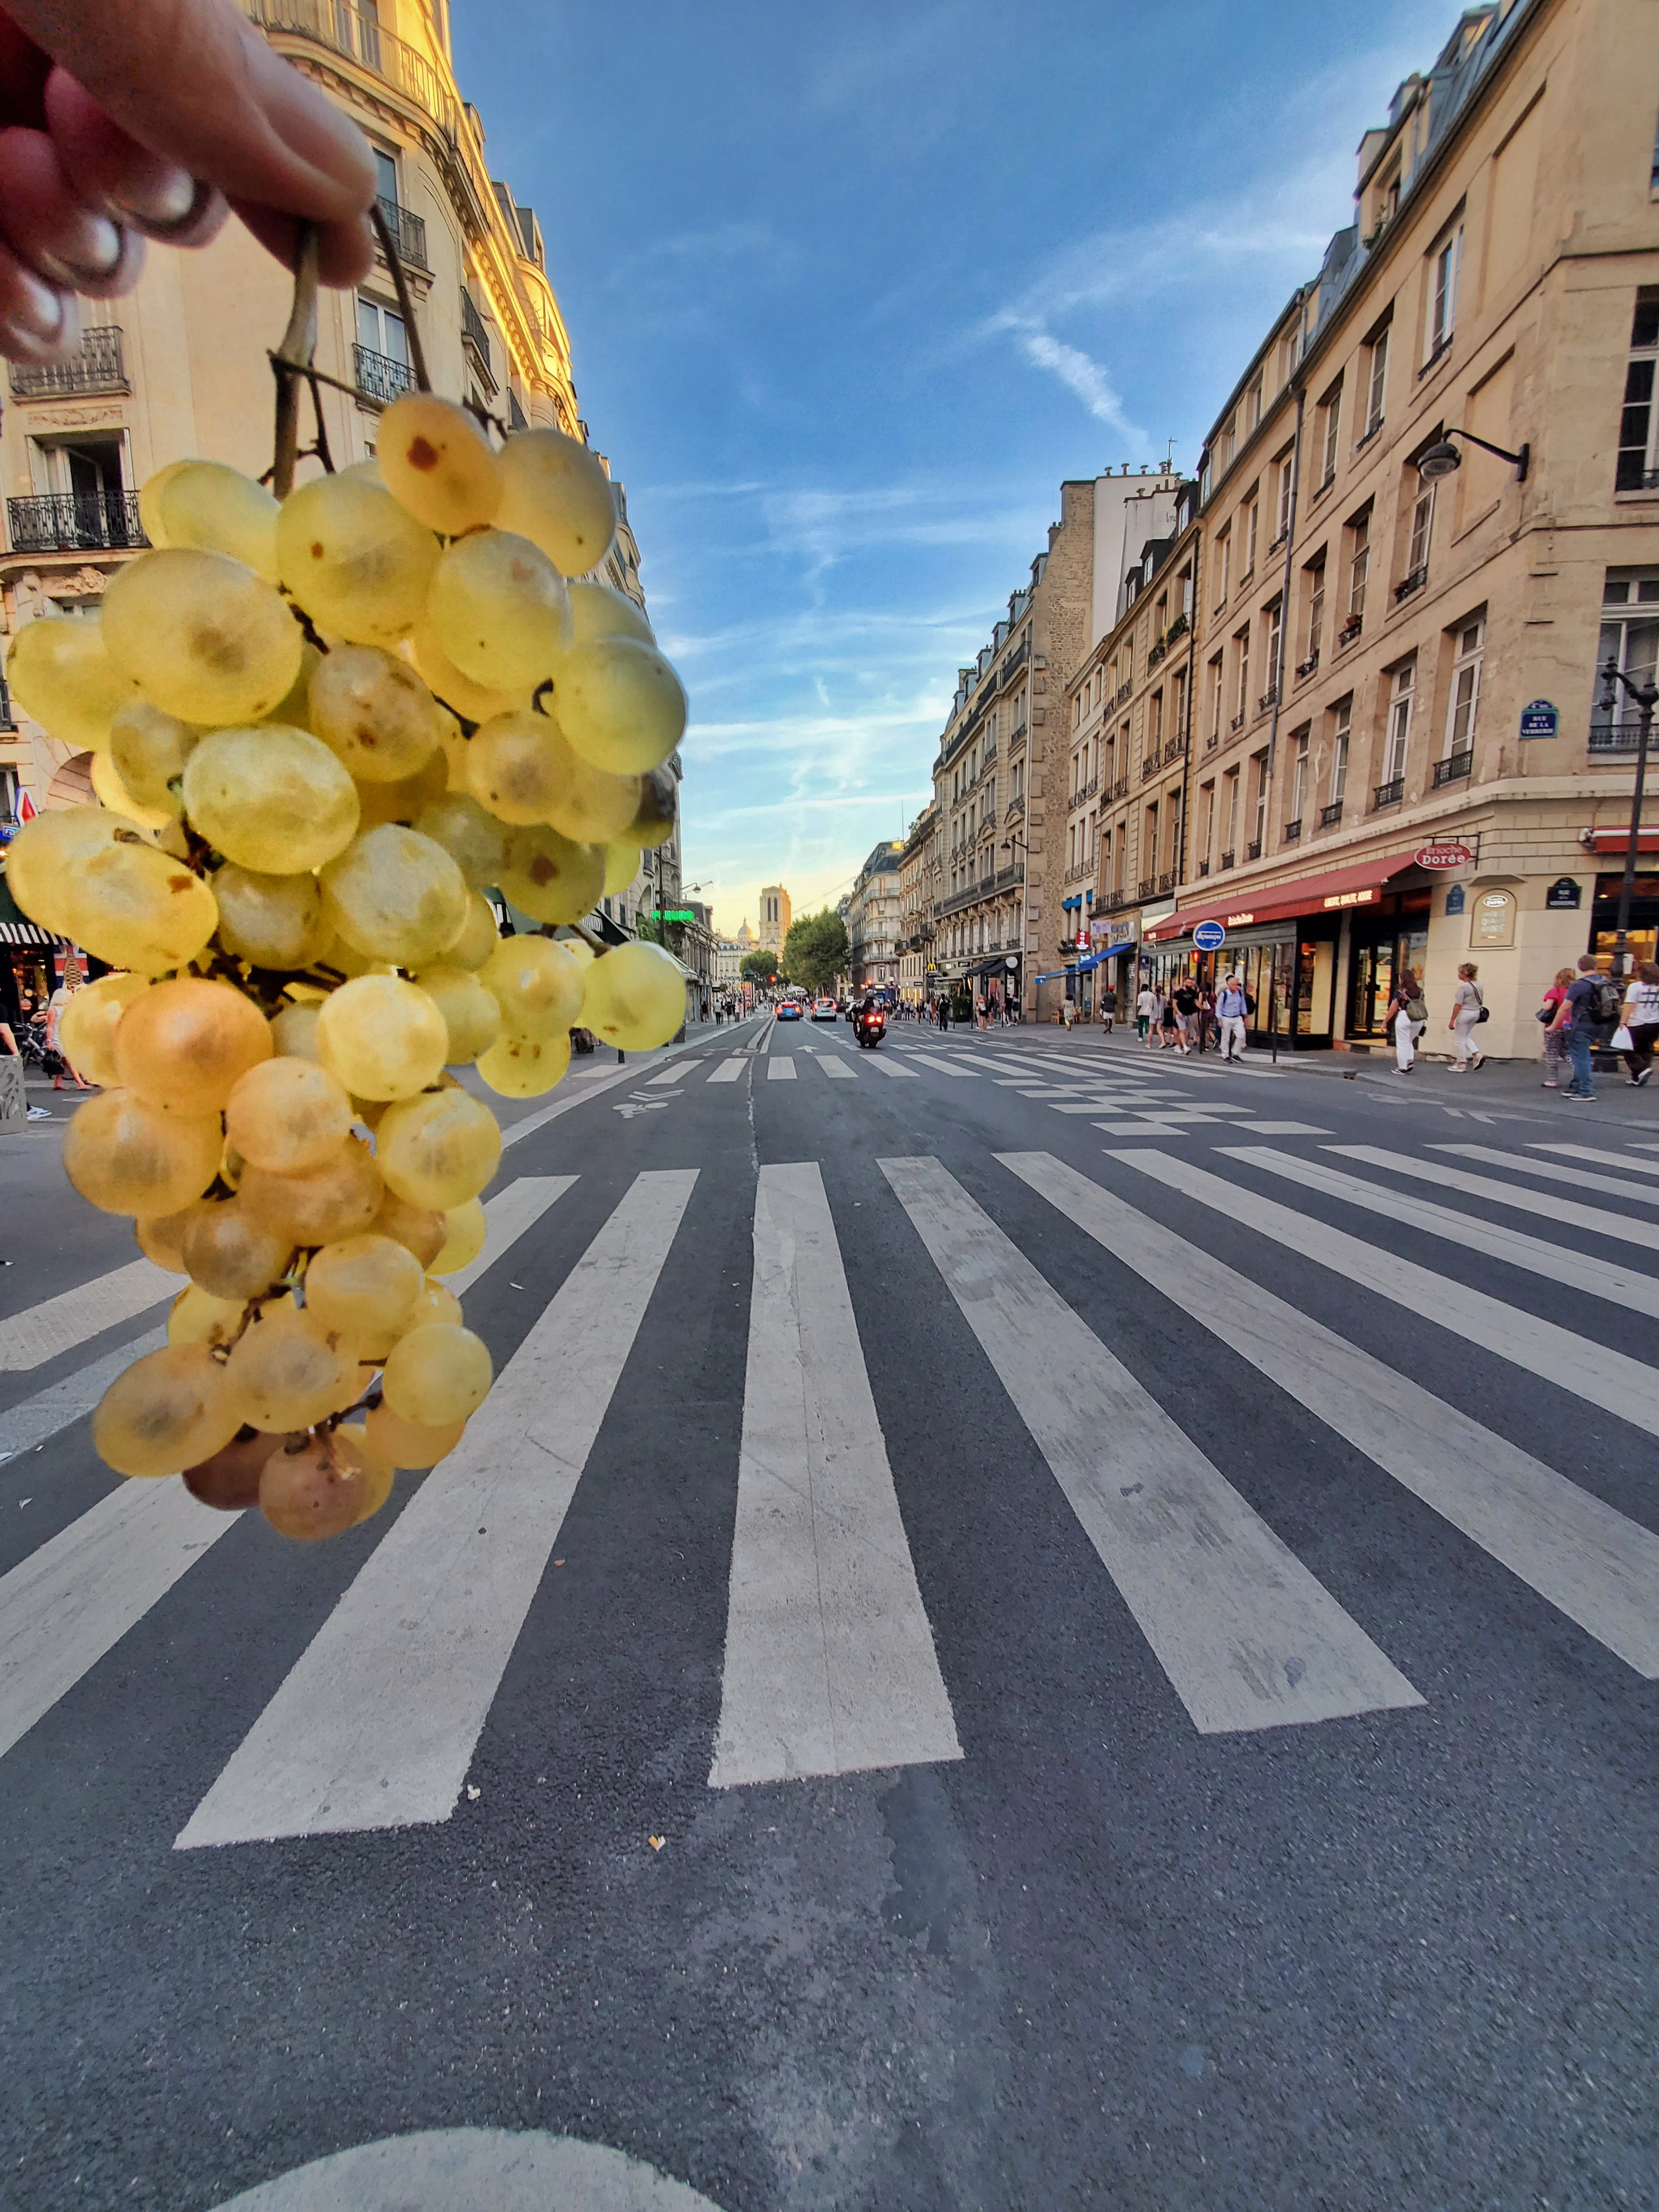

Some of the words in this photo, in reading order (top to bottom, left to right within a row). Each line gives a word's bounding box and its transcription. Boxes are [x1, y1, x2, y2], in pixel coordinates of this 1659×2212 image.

[1426, 845, 1463, 854] Brioche
[1421, 854, 1466, 865] Dorée
[651, 910, 694, 921] FLEURS
